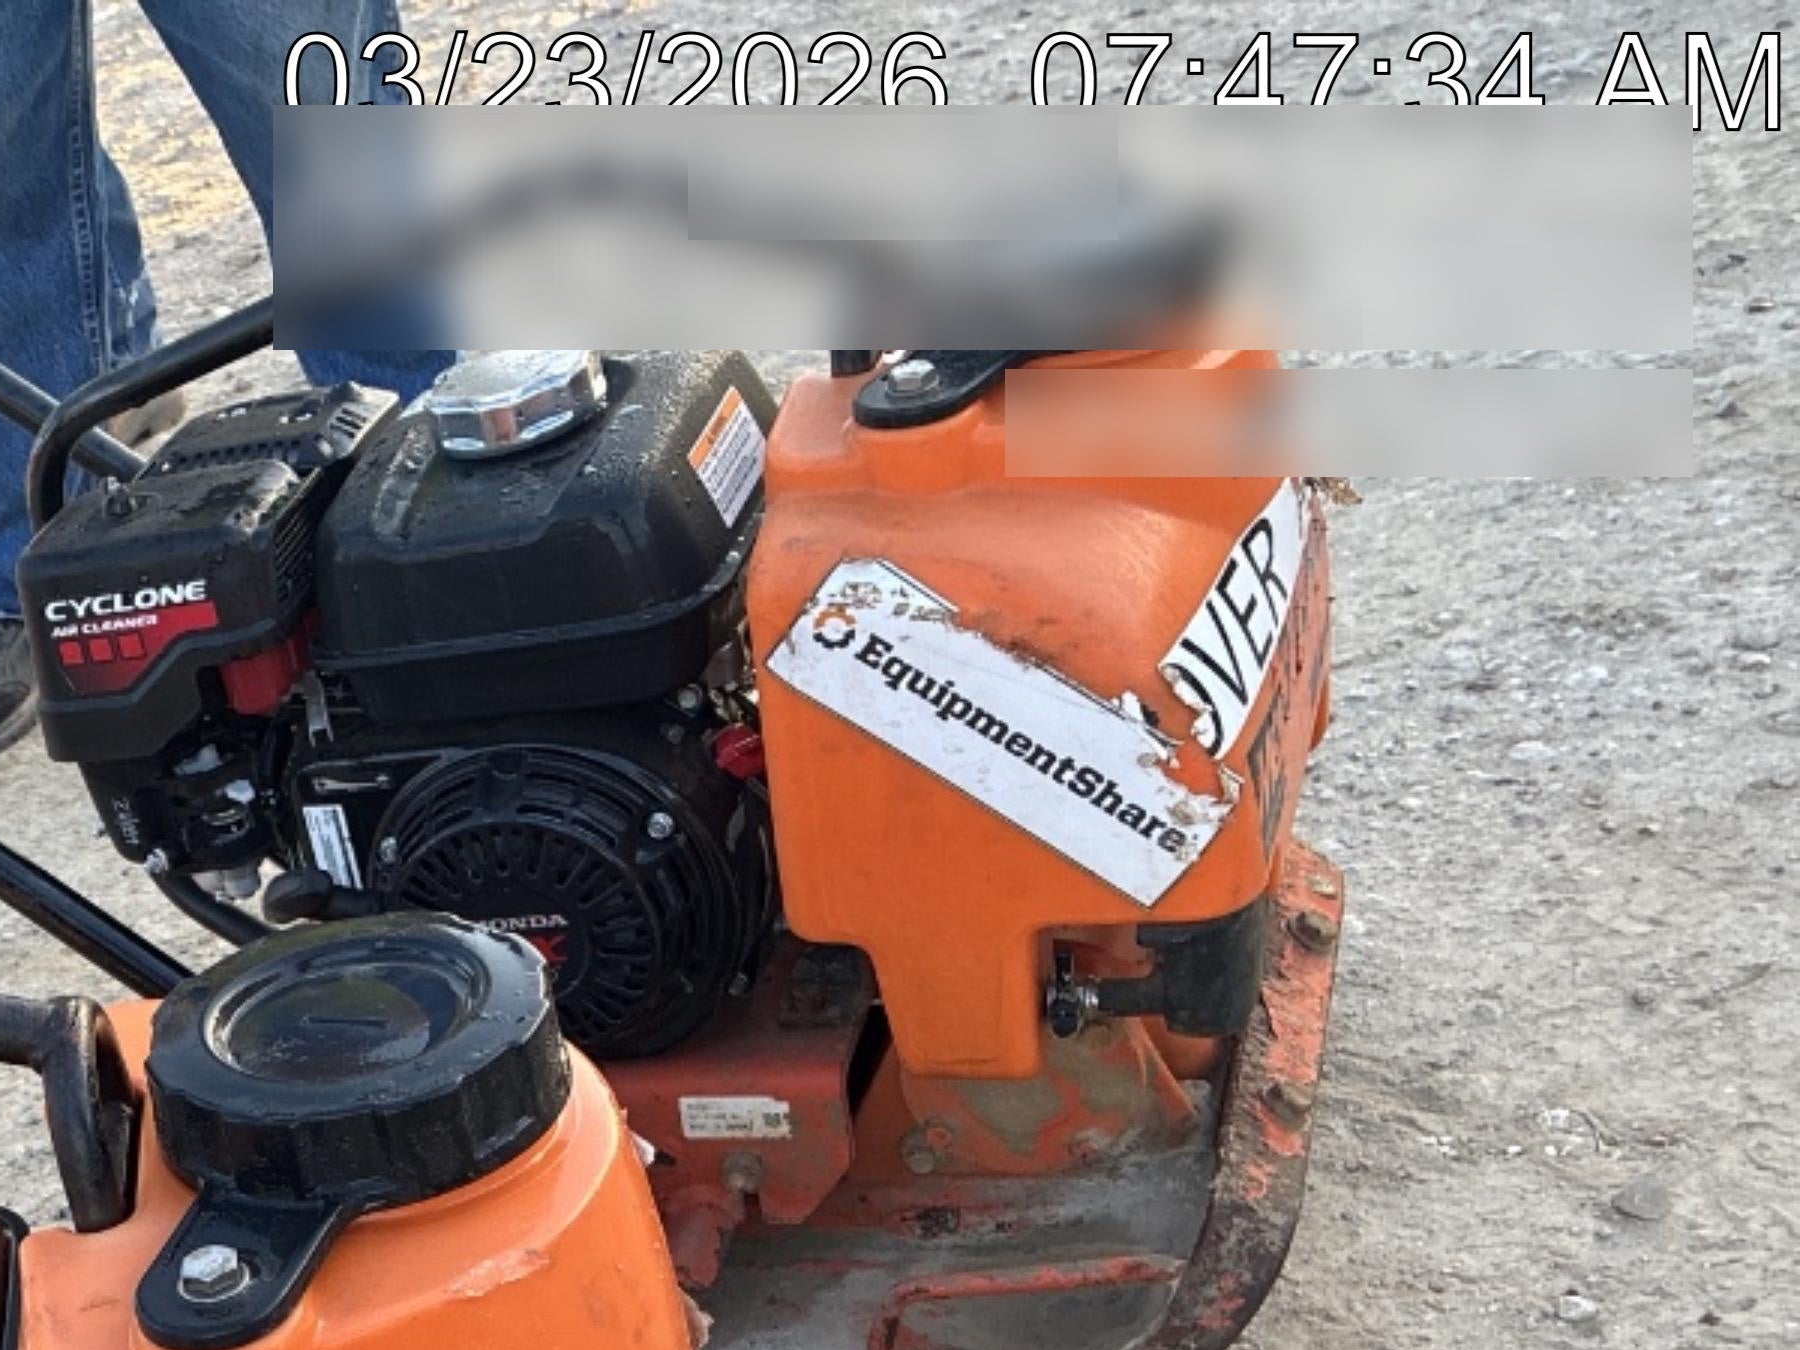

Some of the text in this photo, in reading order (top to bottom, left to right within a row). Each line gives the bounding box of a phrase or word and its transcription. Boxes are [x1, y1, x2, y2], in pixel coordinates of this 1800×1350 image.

[44, 578, 207, 622] CYCLONE
[51, 613, 159, 639] AIR CLEANER
[854, 632, 1188, 853] EquipmentShare
